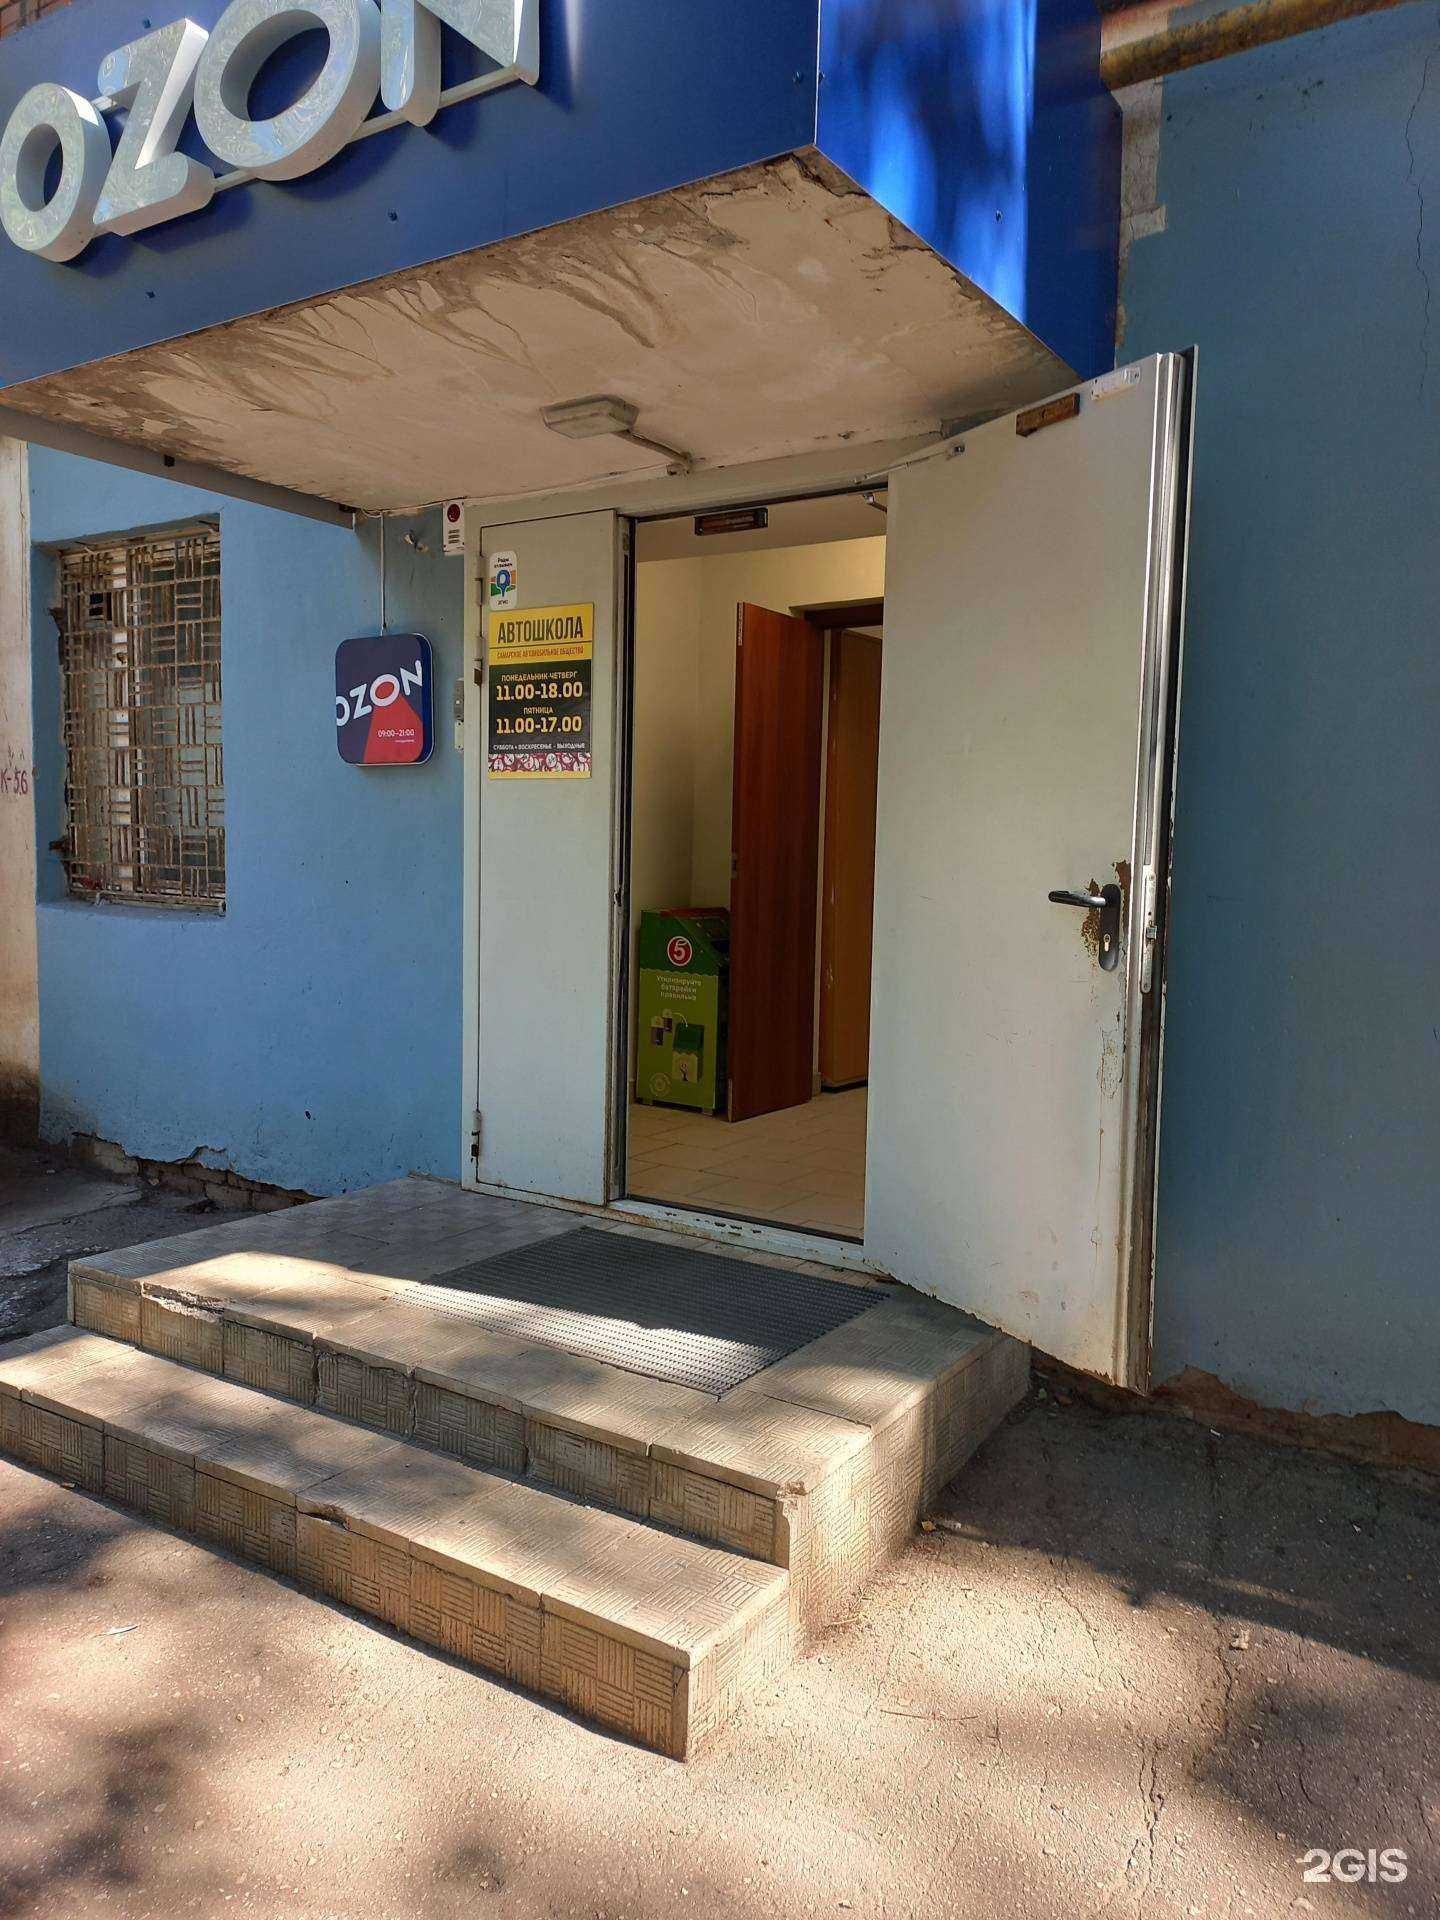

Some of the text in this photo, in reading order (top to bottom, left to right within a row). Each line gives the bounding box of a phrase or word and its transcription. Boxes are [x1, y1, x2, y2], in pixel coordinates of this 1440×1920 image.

[497, 616, 584, 643] АВТОШКОЛА
[501, 671, 578, 682] ПОНЕДЕЛЬНИК-ЧЕТВЕРГ
[335, 659, 423, 727] OZON
[496, 681, 583, 701] 11.00-18.00
[523, 706, 554, 716] ПЯТНИЦА
[496, 715, 582, 734] 11.00-17.00
